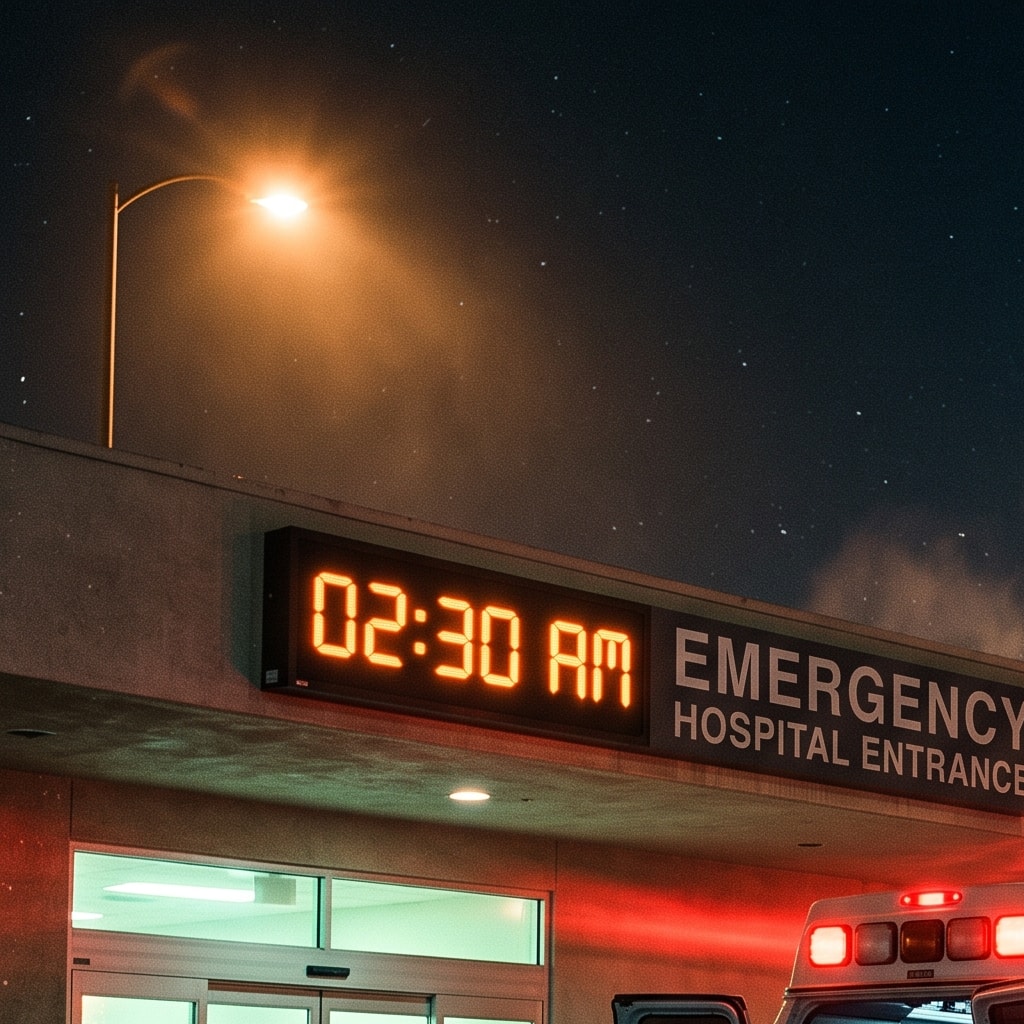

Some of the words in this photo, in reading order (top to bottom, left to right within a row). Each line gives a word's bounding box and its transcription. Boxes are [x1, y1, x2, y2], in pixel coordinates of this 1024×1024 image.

[313, 571, 519, 688] 02:30
[549, 620, 631, 709] AM
[674, 701, 850, 767] HOSPITAL
